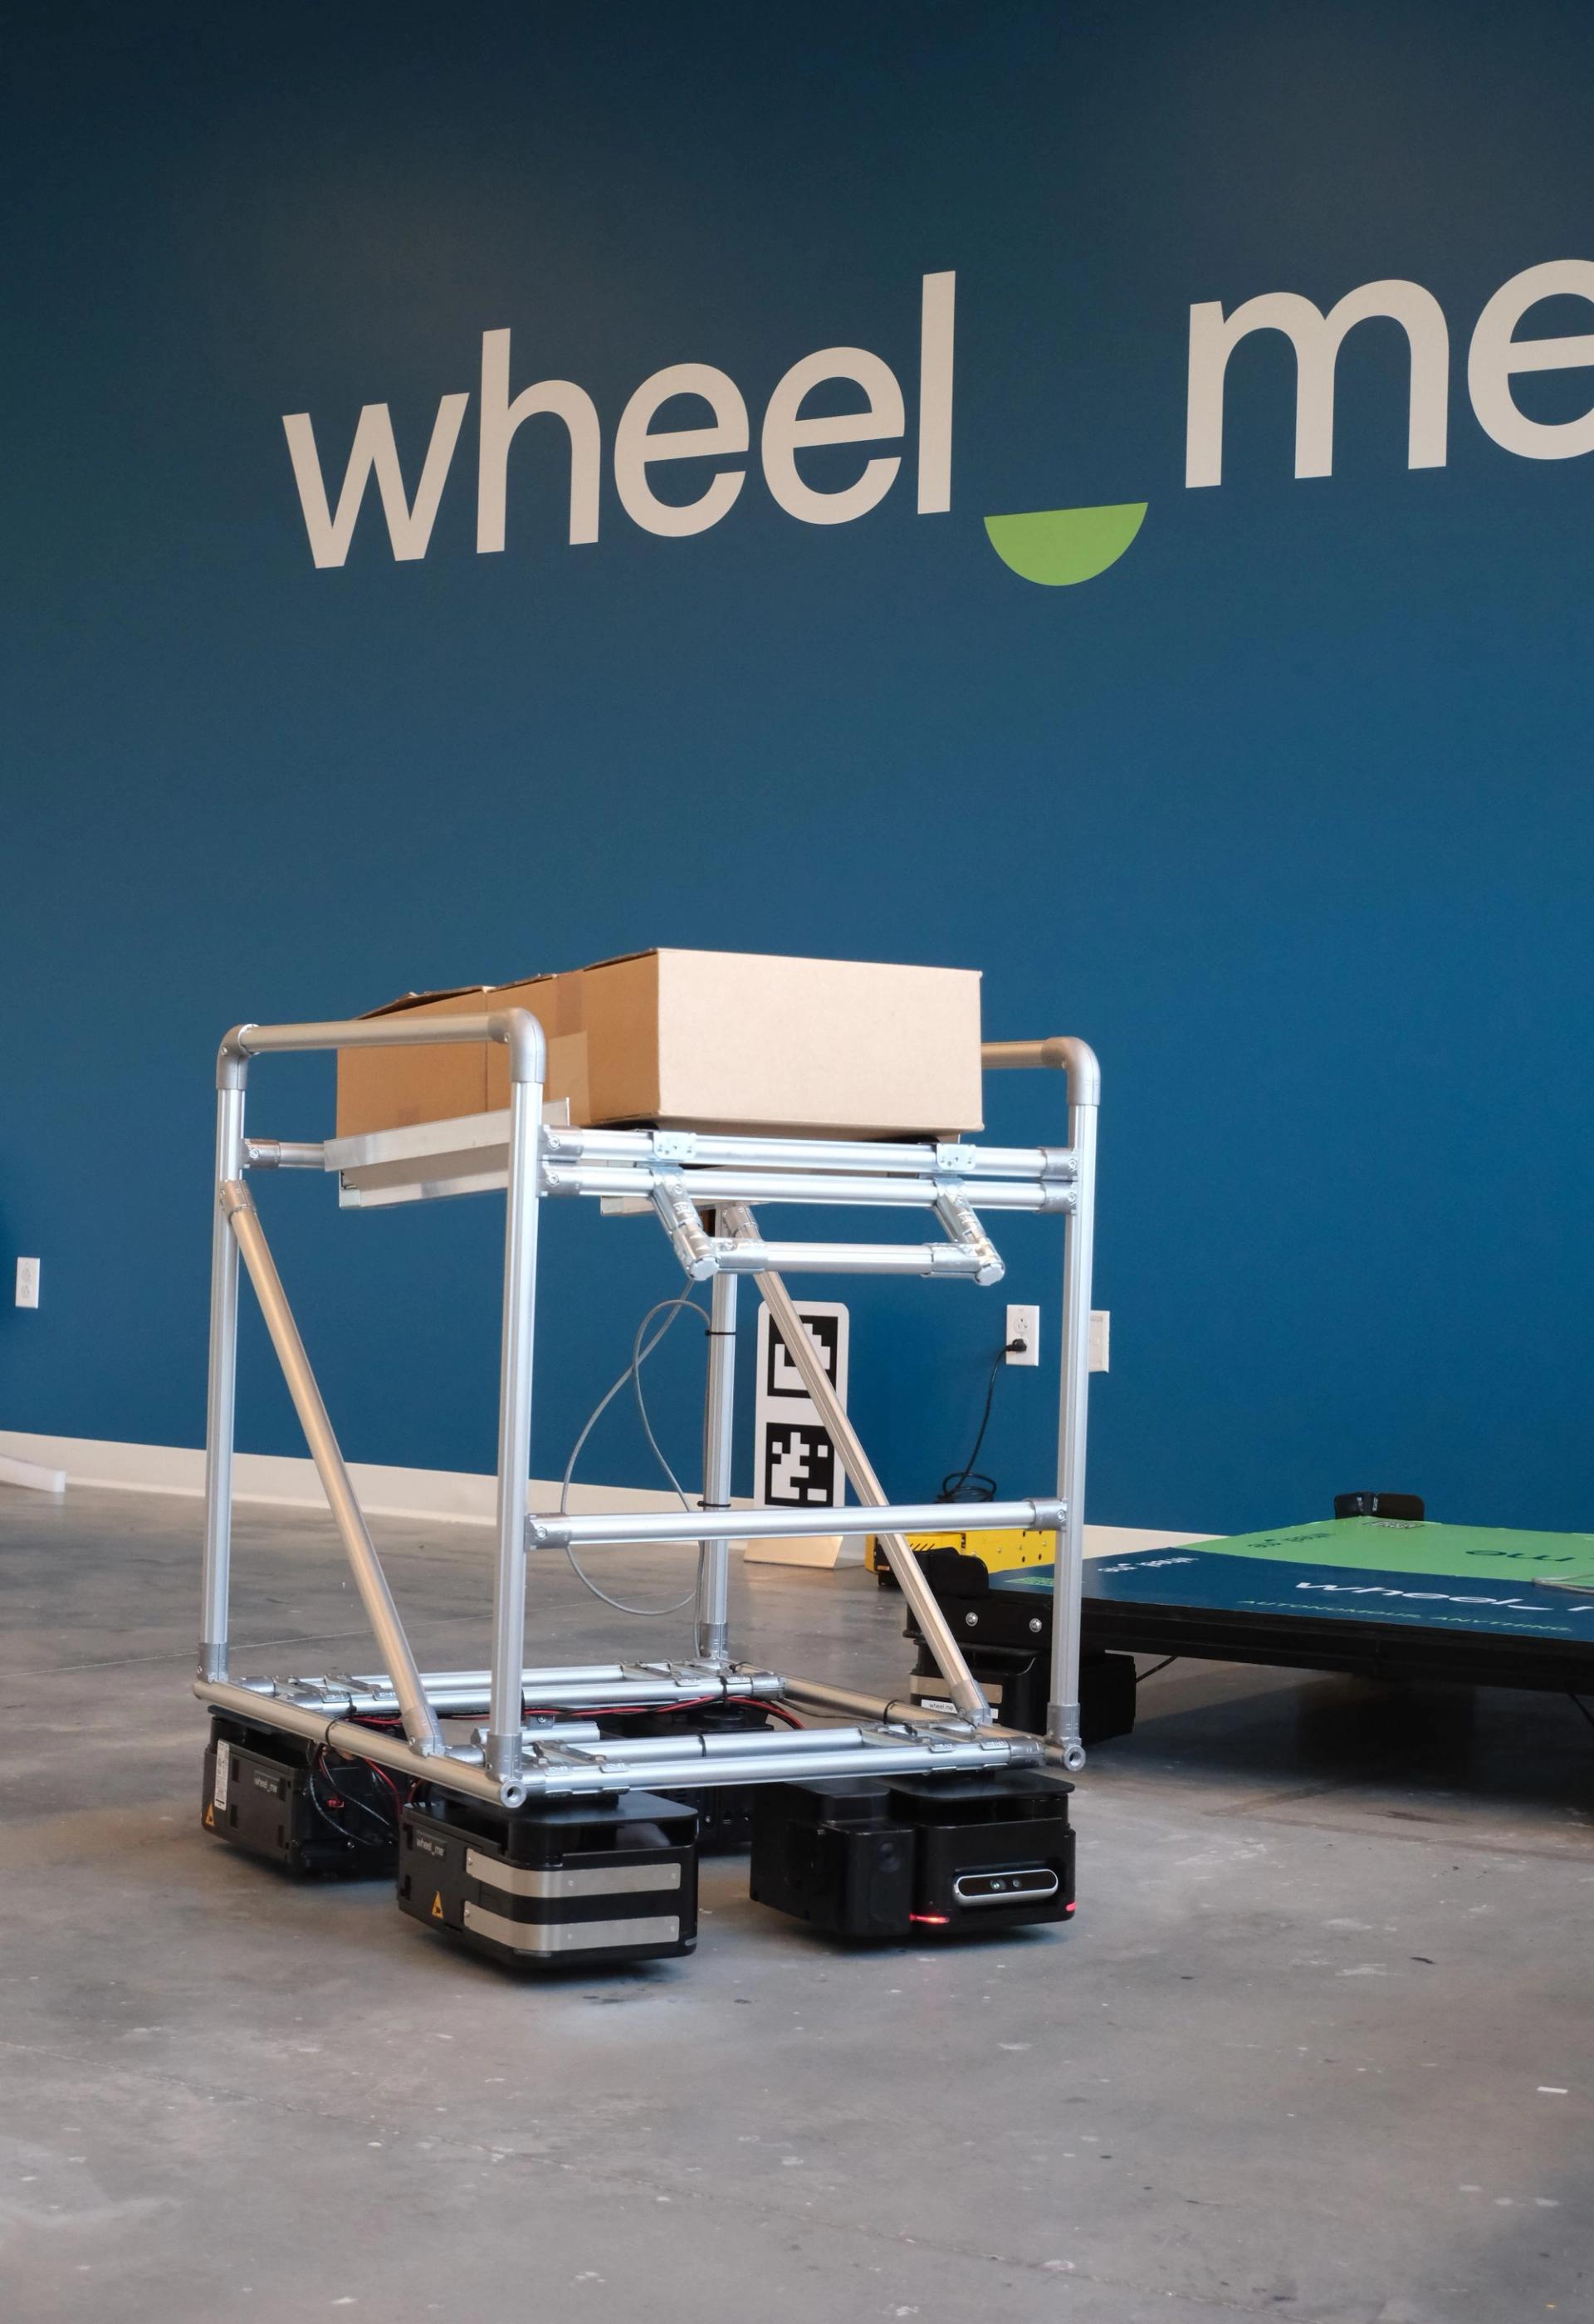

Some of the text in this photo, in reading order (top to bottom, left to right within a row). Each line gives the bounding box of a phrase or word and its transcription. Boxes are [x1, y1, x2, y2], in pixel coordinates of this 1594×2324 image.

[282, 258, 1594, 570] wheel me
[1295, 1581, 1523, 1605] wheel
